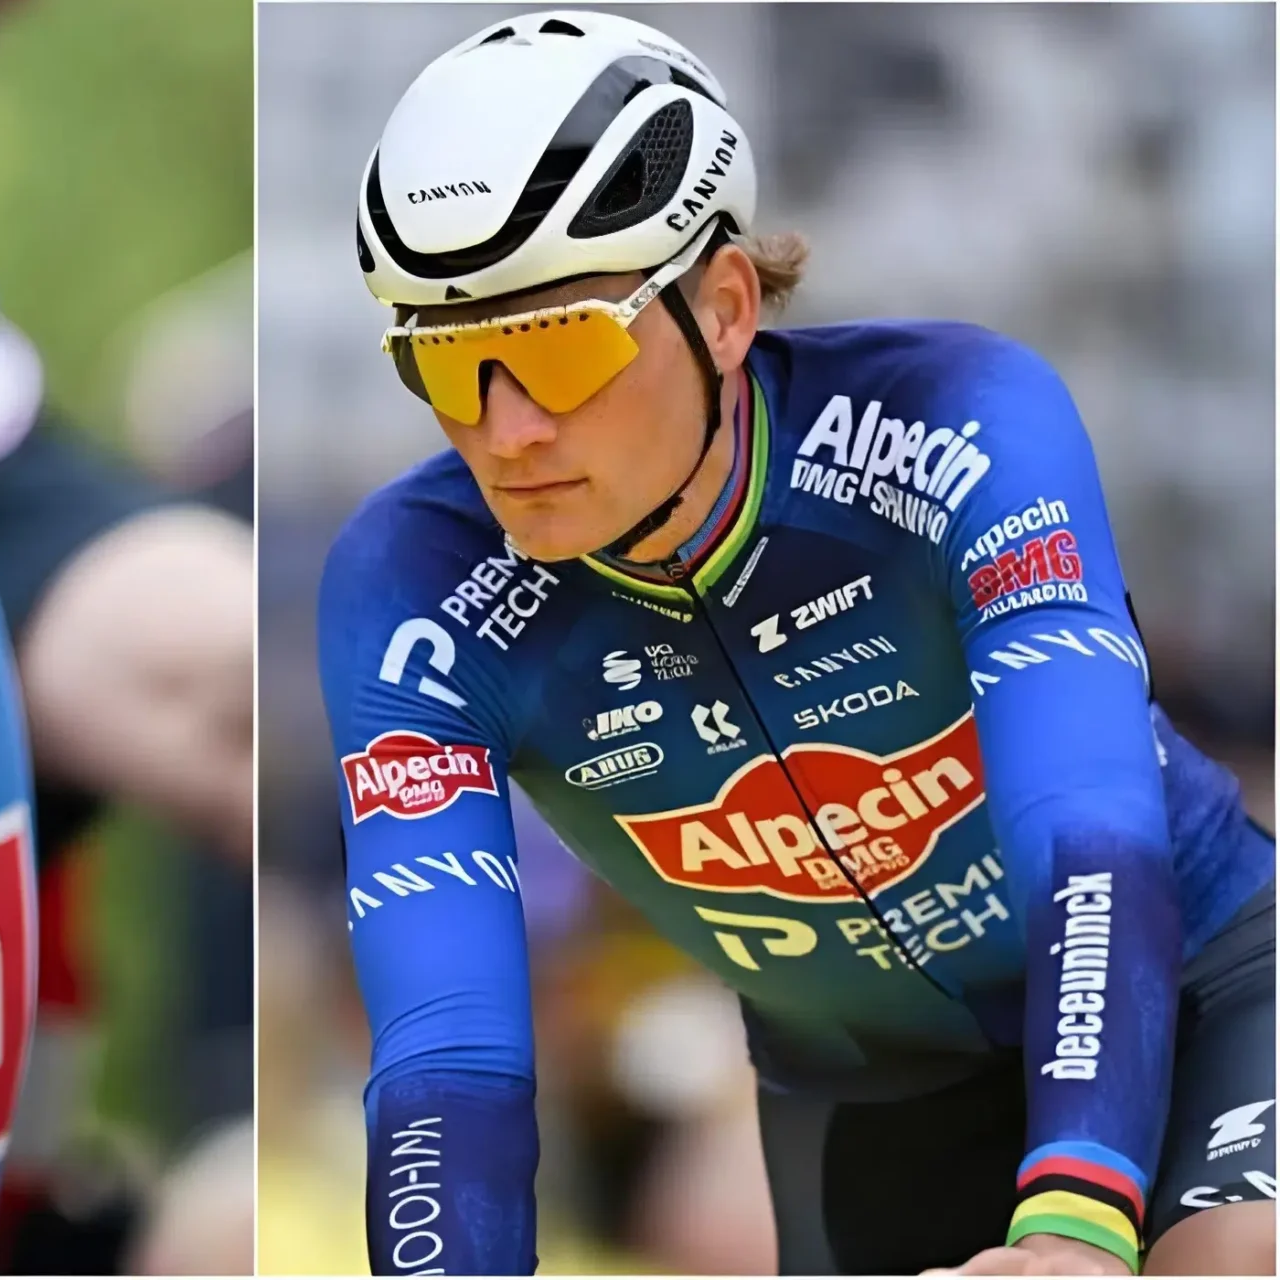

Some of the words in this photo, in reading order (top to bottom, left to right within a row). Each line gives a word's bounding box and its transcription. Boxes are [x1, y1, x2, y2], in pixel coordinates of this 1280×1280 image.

[667, 129, 738, 232] CANYON
[790, 459, 859, 505] DMG
[797, 395, 991, 512] Alpecin
[439, 532, 529, 627] PREM
[476, 564, 560, 651] TECH
[790, 575, 873, 630] ZWIFT
[793, 680, 920, 730] SKODA
[970, 627, 1150, 698] ANYO
[355, 746, 480, 801] Alpecin
[681, 756, 974, 877] Alpecin
[348, 850, 523, 931] ANYO
[836, 854, 1004, 945] PREMI
[1041, 872, 1113, 1080] deceuninck
[389, 1117, 444, 1276] WHOO
